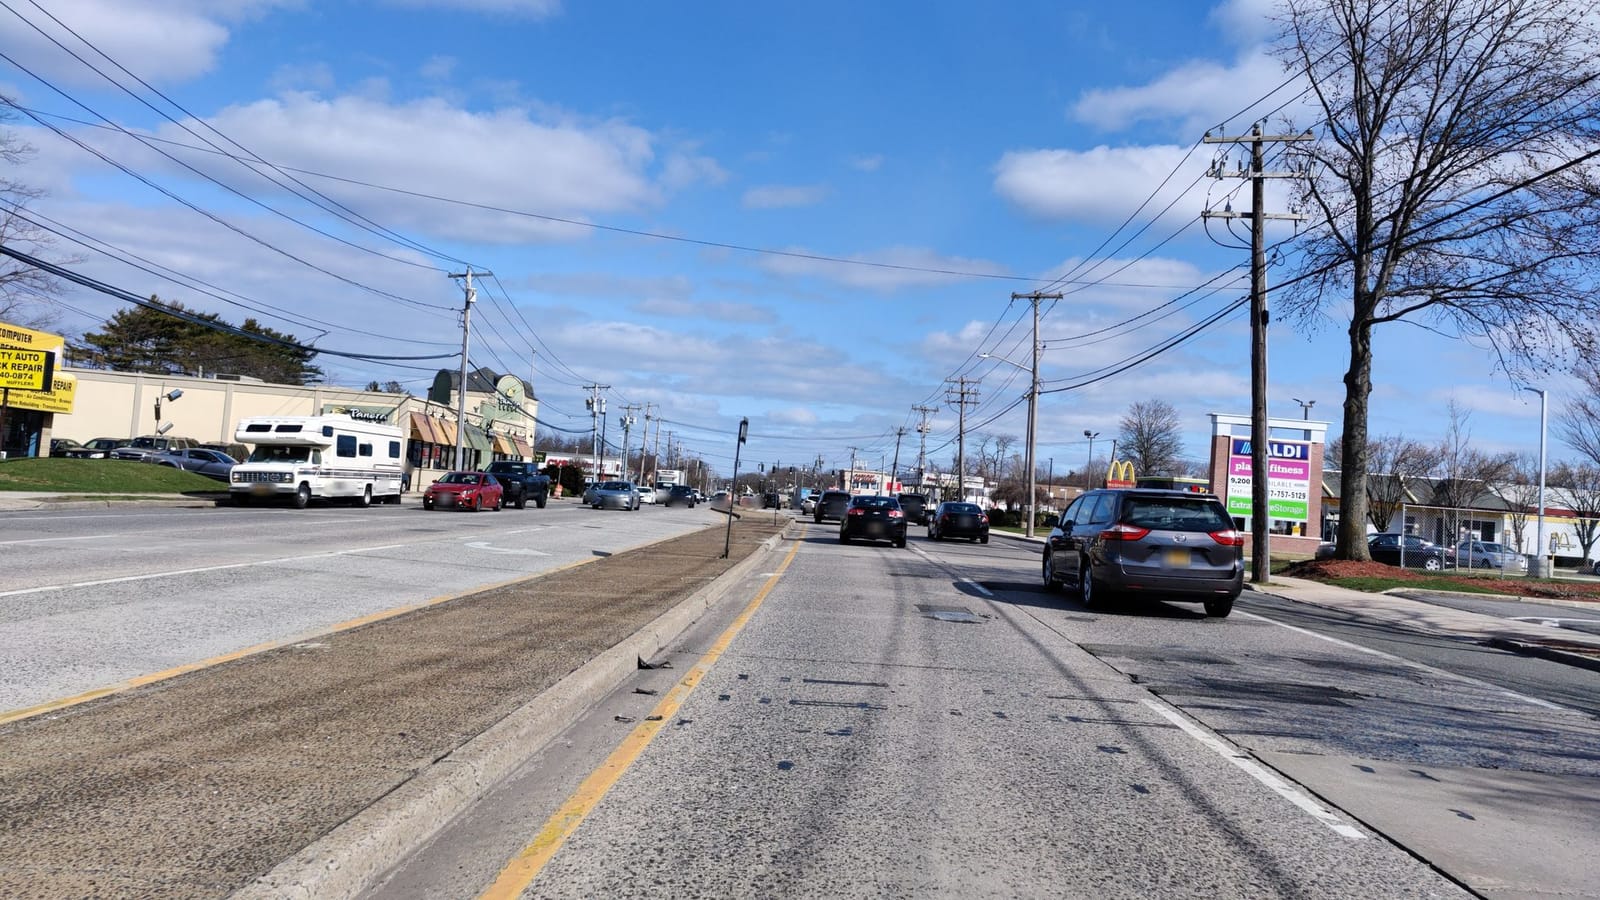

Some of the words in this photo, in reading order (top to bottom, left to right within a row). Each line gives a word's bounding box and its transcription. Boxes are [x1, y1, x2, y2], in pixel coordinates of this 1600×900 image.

[15, 353, 40, 362] AUTO
[11, 363, 43, 372] REPAIR
[53, 379, 72, 391] REPAIR
[1269, 464, 1304, 475] fitness
